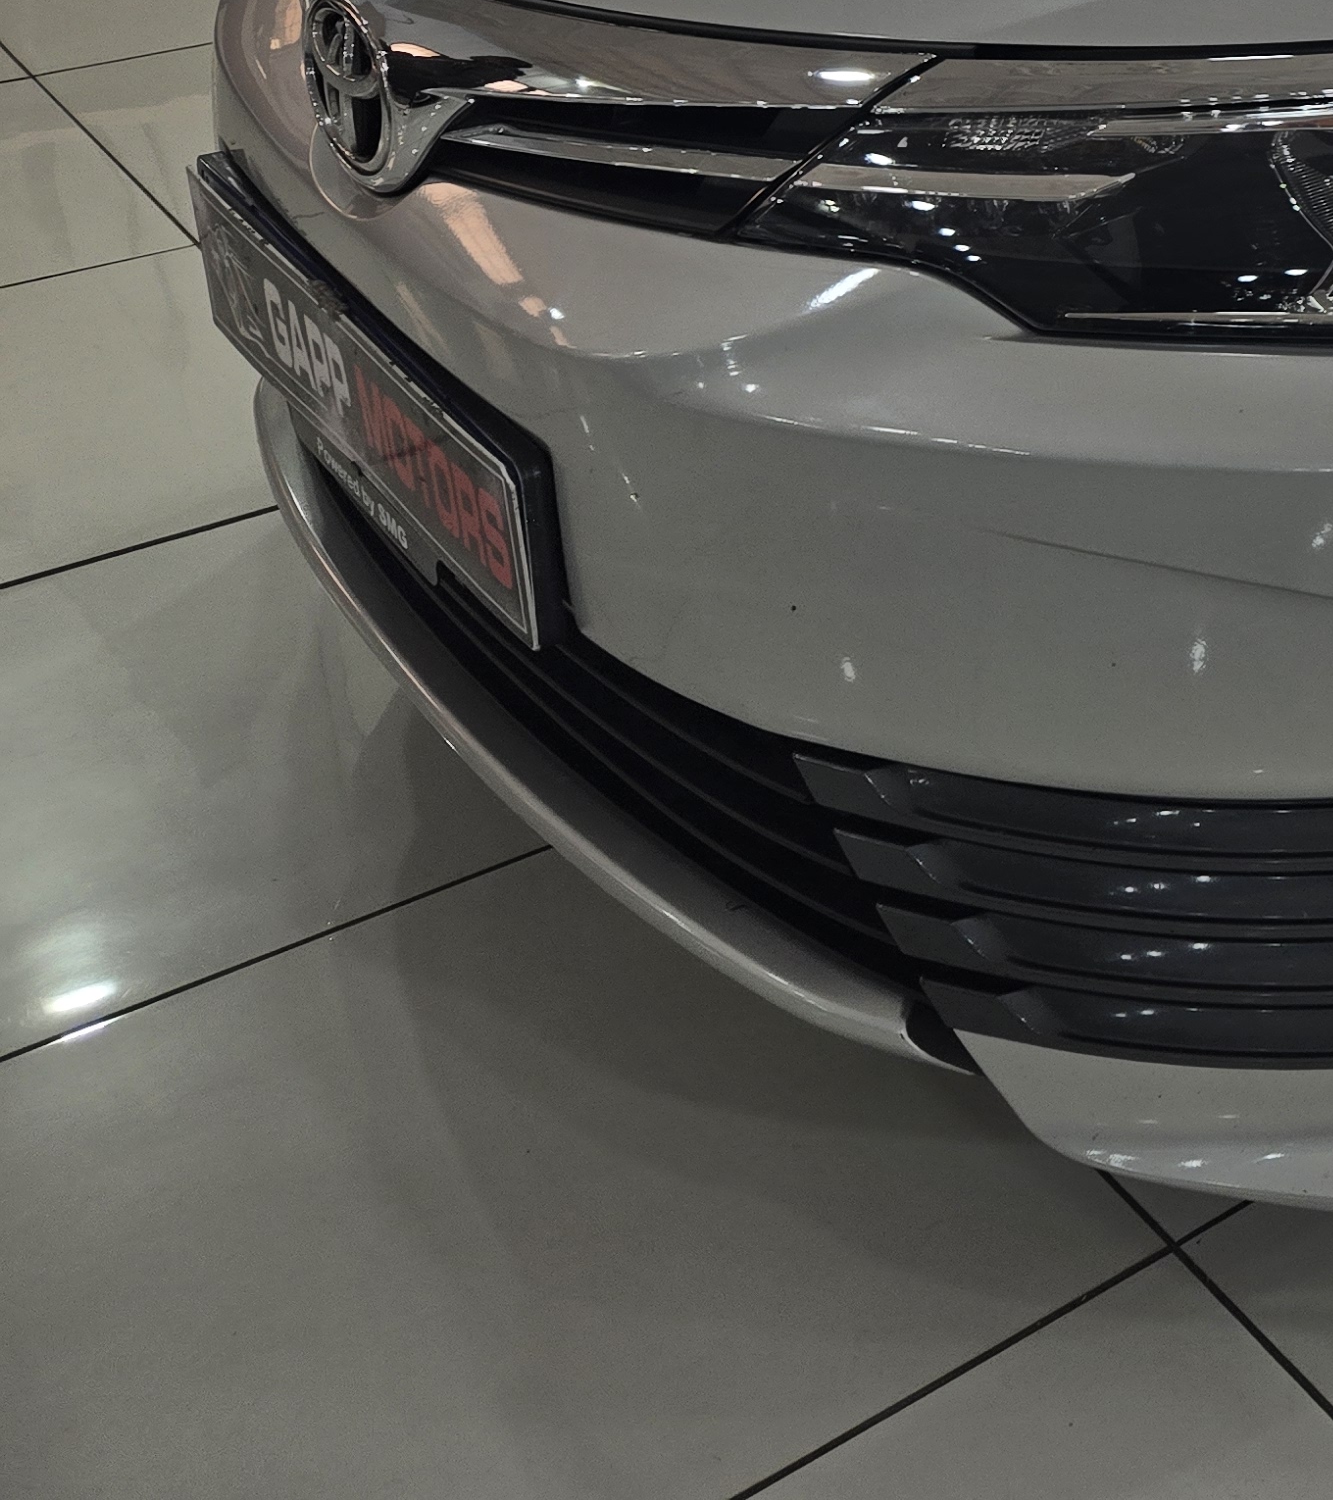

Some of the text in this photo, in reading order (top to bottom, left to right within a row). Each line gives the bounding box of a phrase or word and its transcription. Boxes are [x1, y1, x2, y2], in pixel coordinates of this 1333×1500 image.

[263, 278, 513, 590] GAPP MOTORS
[317, 436, 408, 550] Powered by SMG
